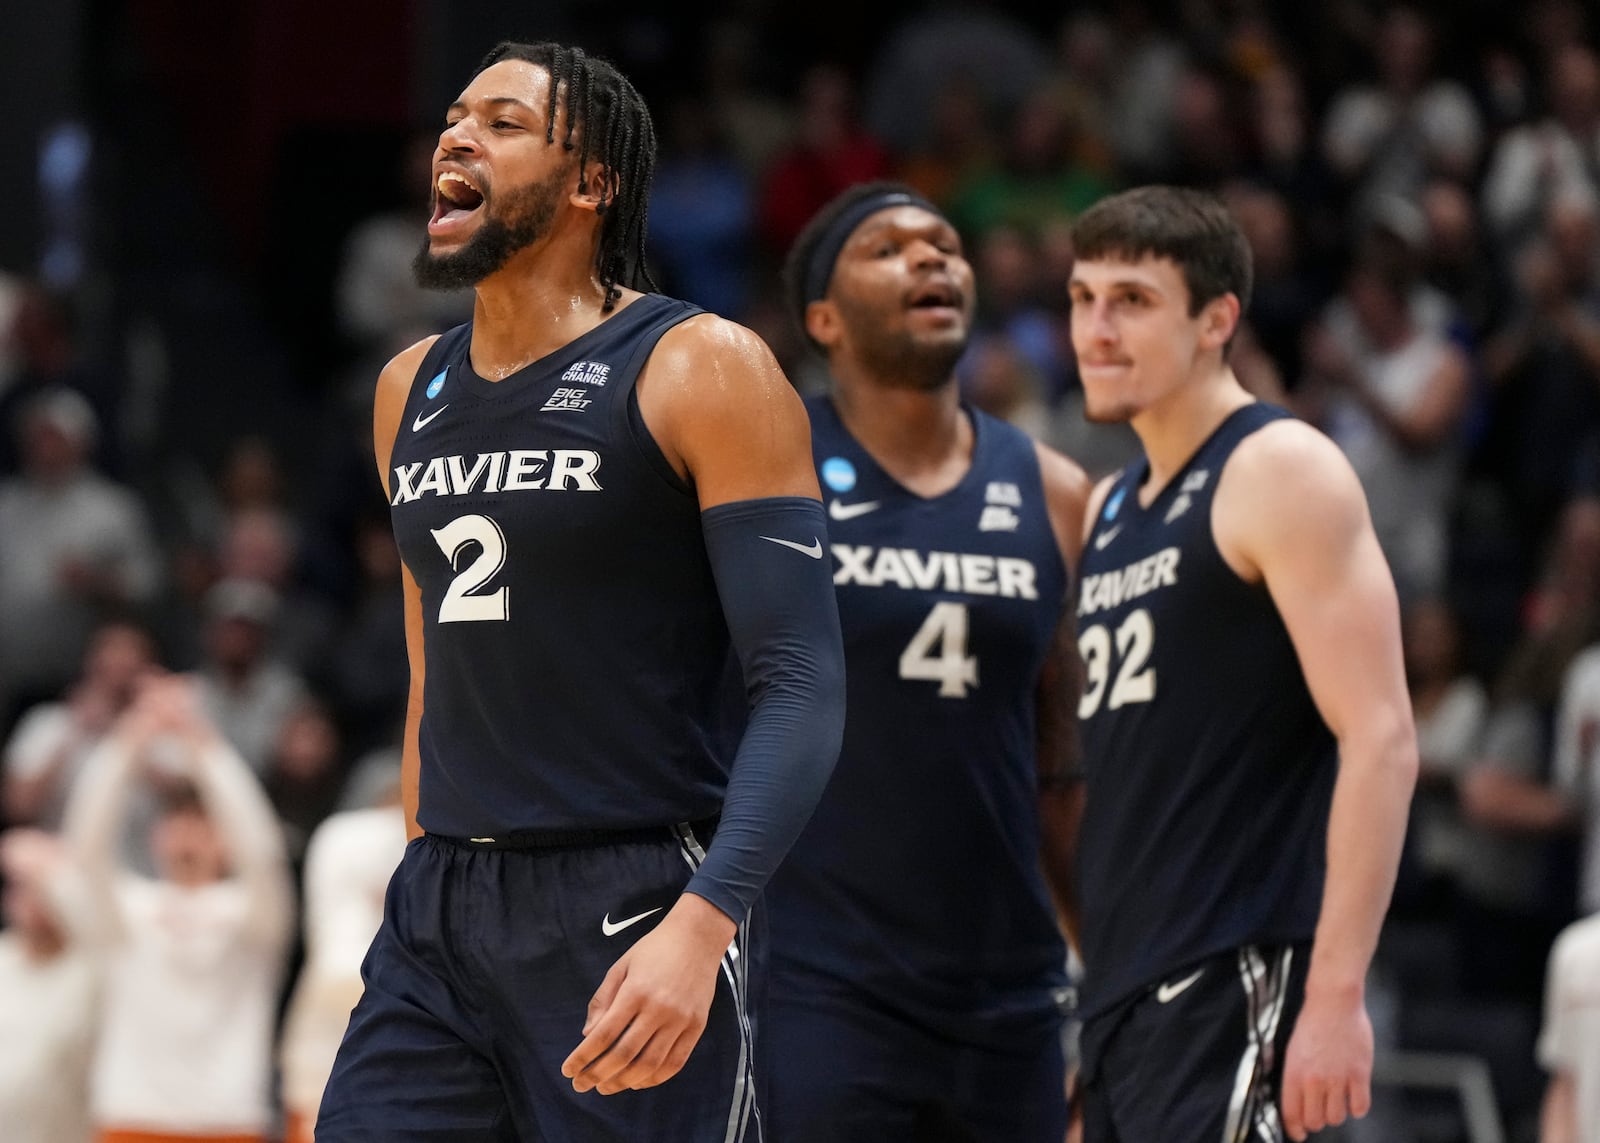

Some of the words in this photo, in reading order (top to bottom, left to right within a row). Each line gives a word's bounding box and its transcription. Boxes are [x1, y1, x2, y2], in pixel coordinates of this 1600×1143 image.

[552, 388, 587, 399] BIG
[562, 371, 608, 386] CHANGE
[569, 362, 586, 372] BE
[587, 363, 610, 376] THE
[544, 398, 592, 409] EAST
[391, 449, 603, 506] XAVIER
[430, 514, 510, 624] 2
[830, 543, 1039, 600] XAVIER
[1077, 546, 1181, 618] XAVIER
[898, 601, 980, 698] 4
[1077, 608, 1157, 720] 32
